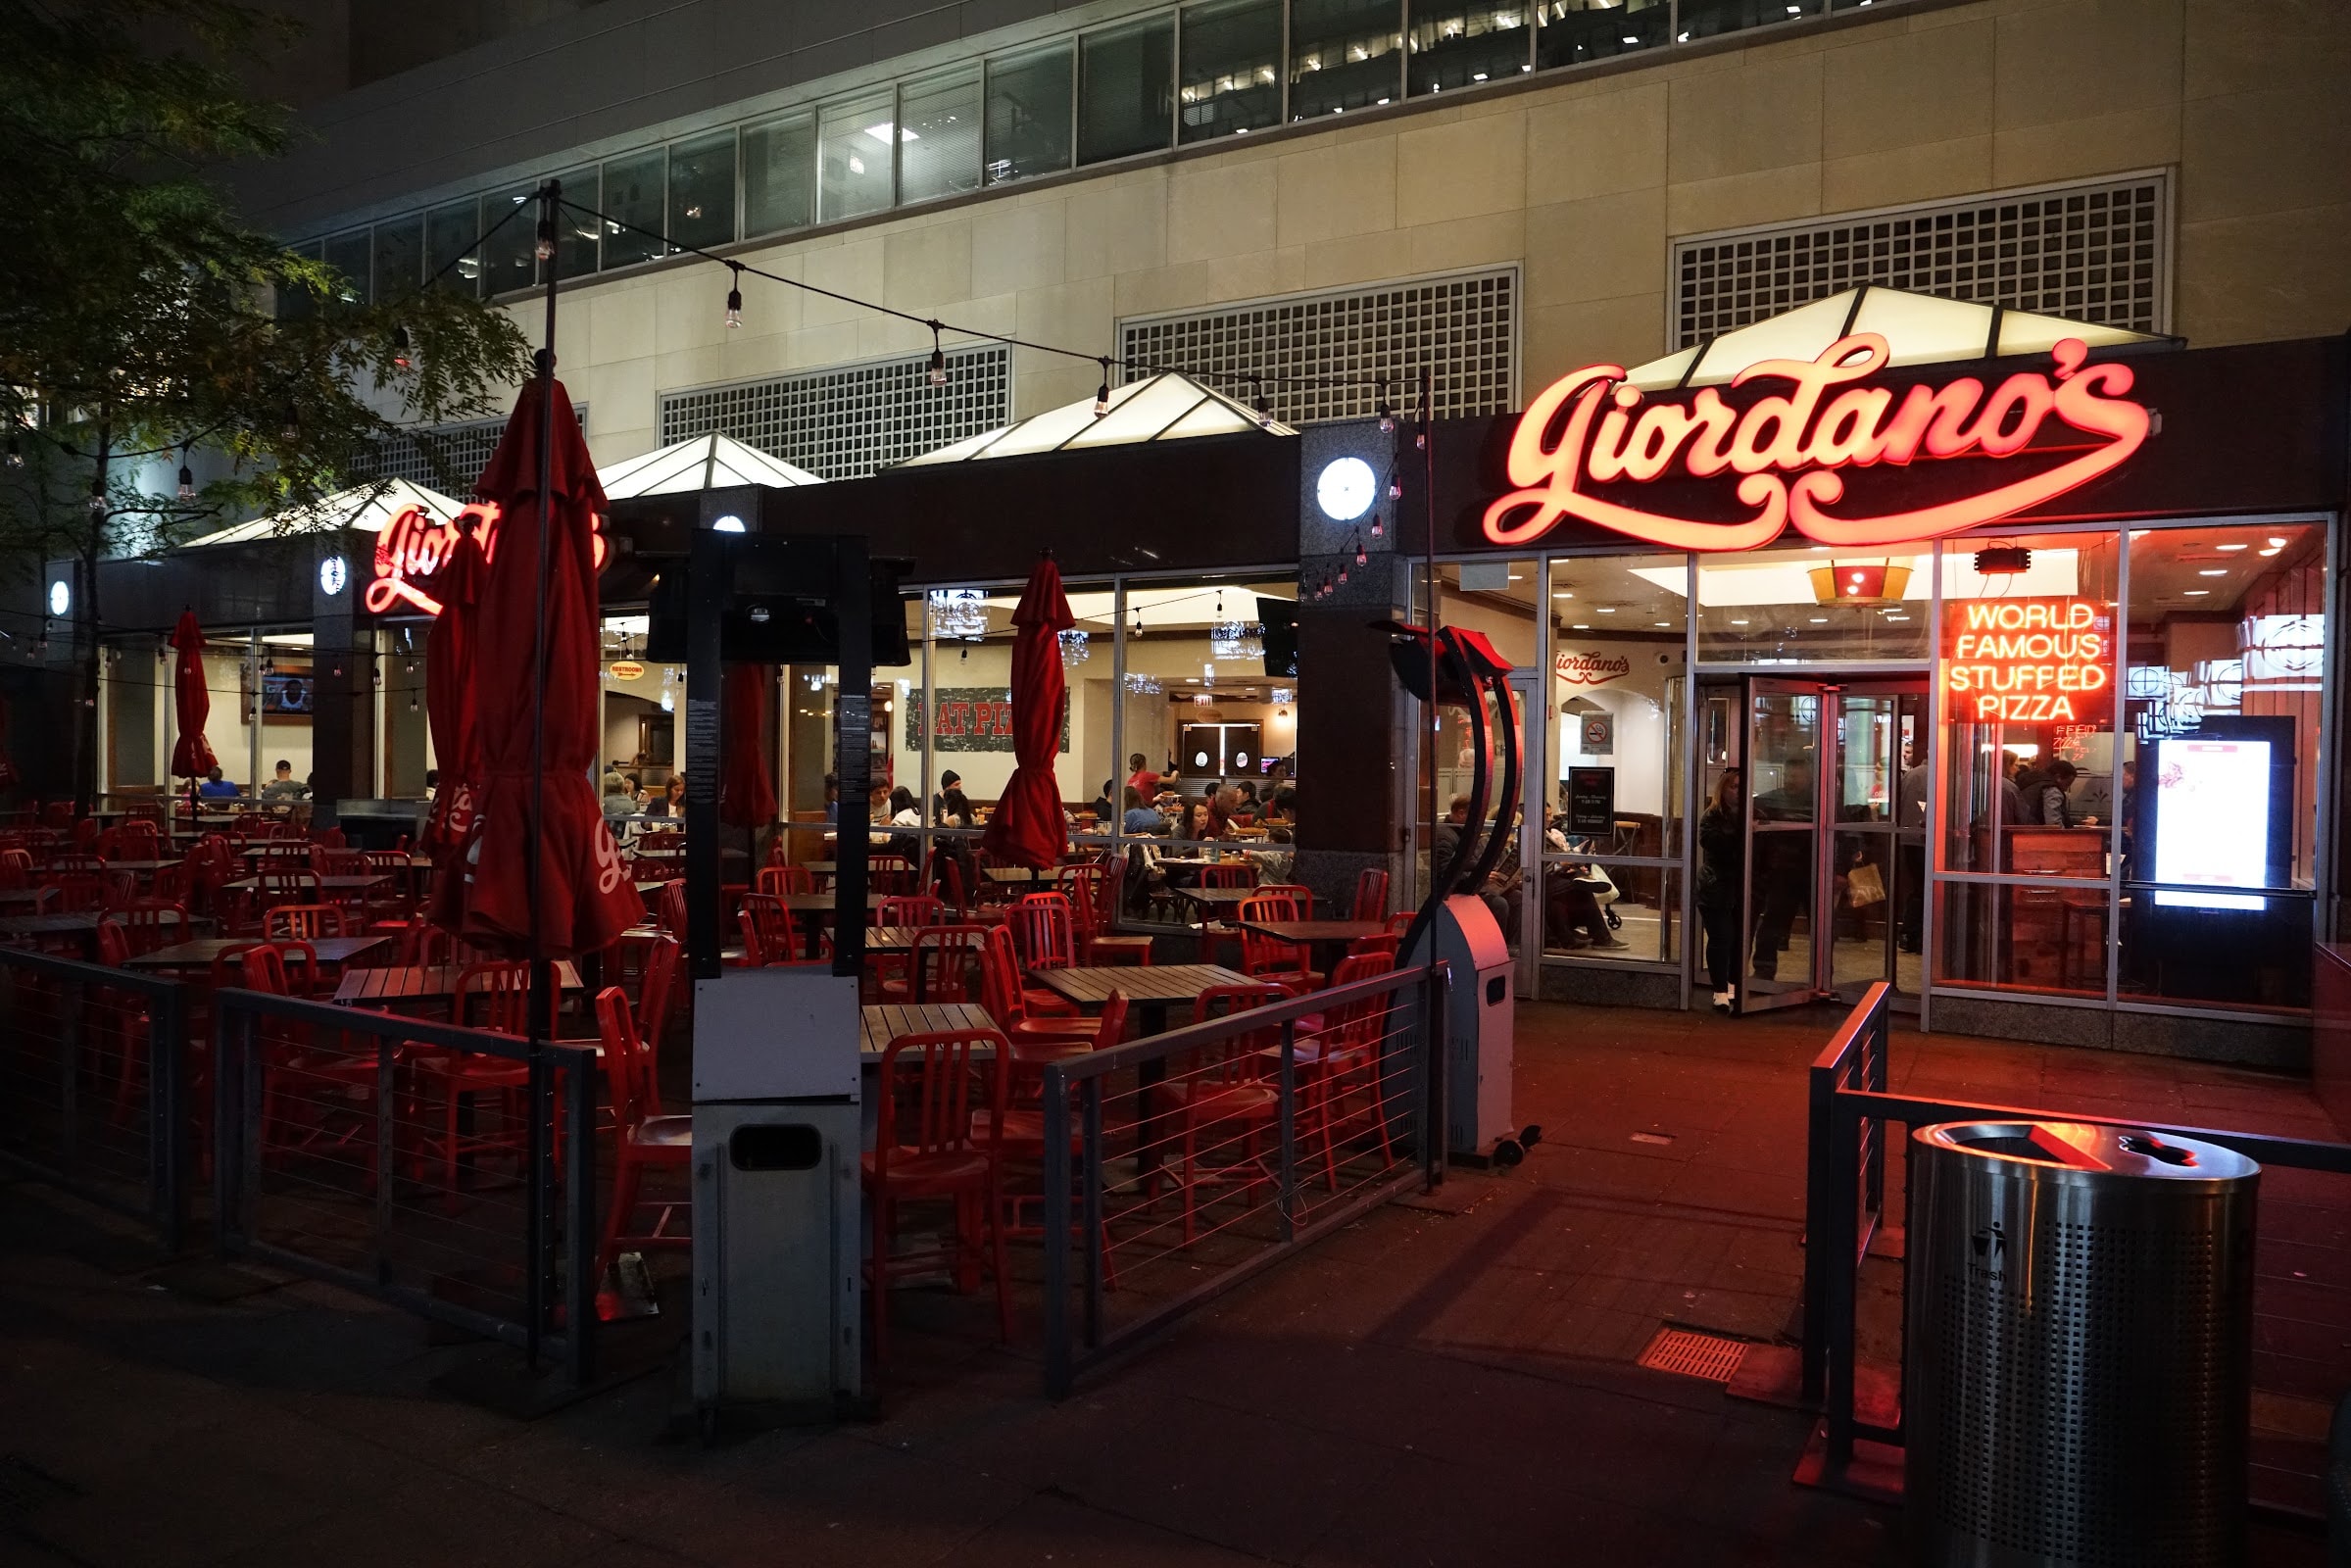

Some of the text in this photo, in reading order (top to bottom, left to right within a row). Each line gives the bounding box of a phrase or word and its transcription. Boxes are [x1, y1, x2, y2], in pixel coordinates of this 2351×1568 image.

[1483, 332, 2150, 551] Giordano's
[1967, 604, 2094, 630] WORLD
[1957, 634, 2101, 660] FAMOUS
[1556, 651, 1630, 685] iordano's
[1949, 664, 2106, 691] STUFFED
[1978, 695, 2075, 720] PIZZA
[1967, 1262, 2007, 1283] Trash
